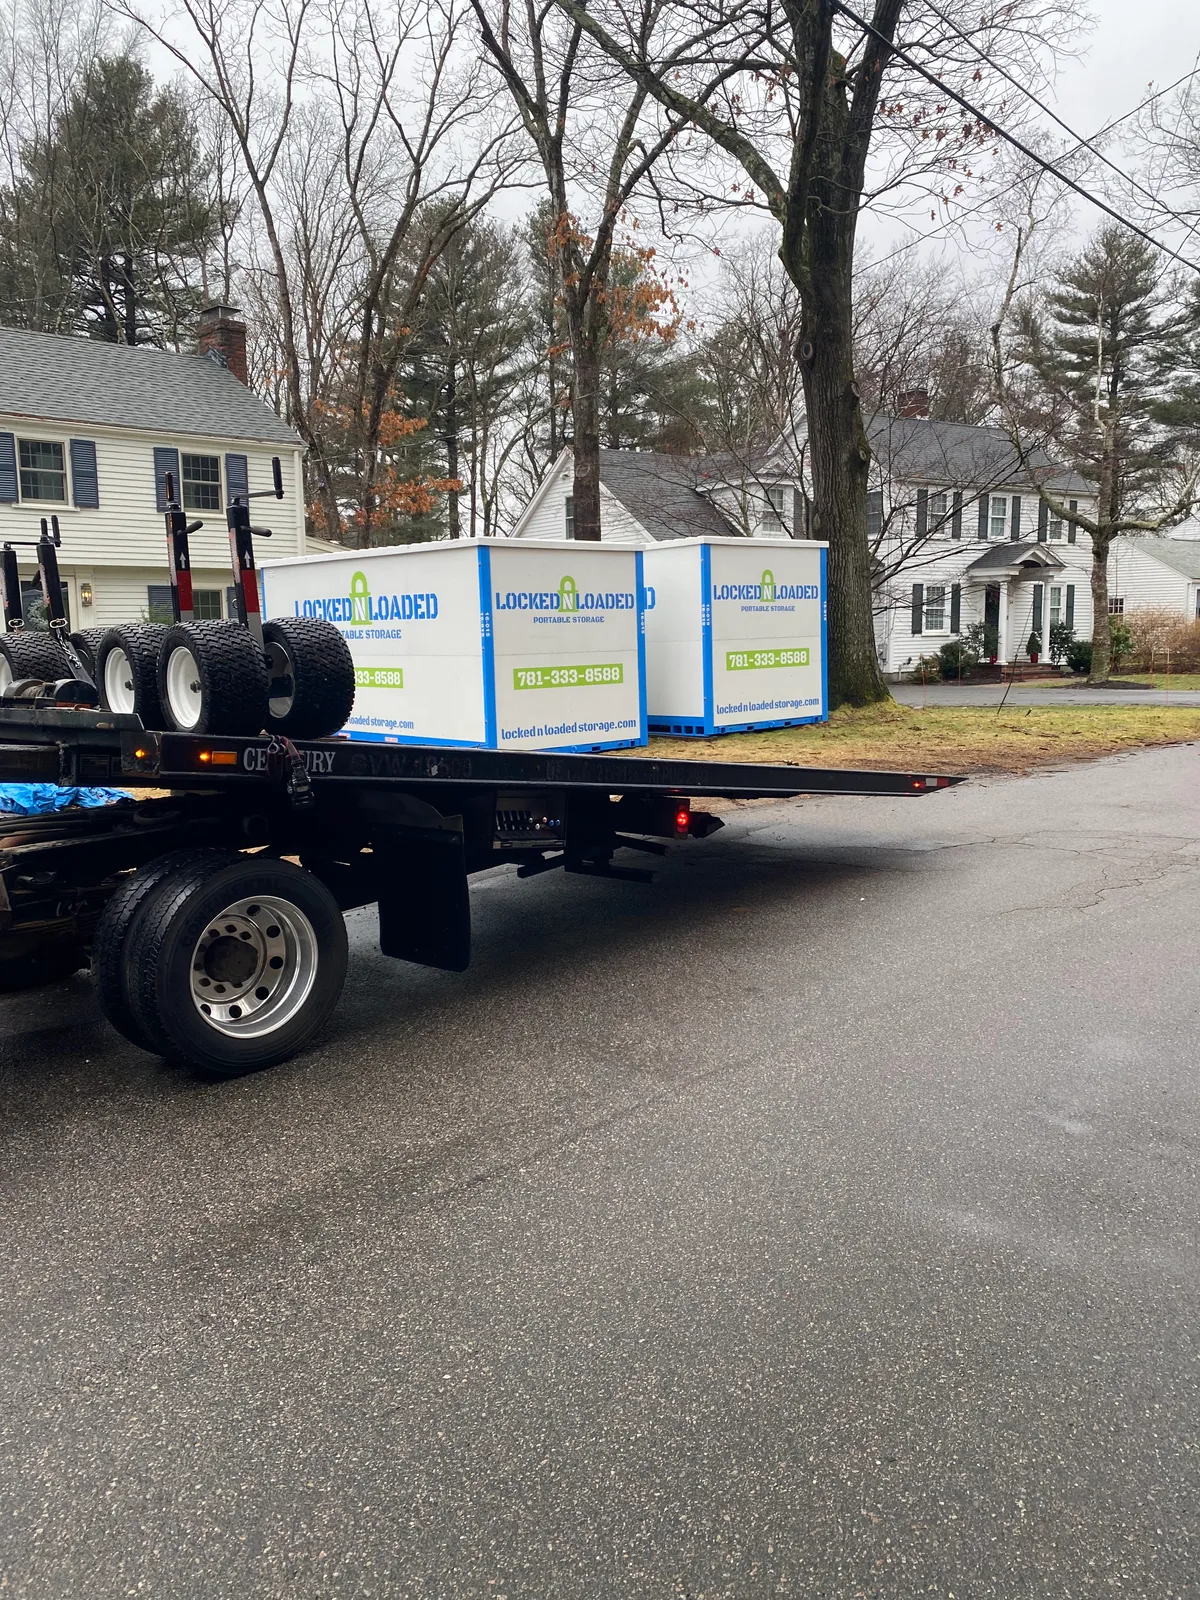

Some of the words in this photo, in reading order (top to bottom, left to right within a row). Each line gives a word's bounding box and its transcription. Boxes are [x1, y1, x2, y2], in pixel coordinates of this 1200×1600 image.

[496, 592, 559, 610] LOCKED
[575, 593, 634, 609] LOADED
[713, 585, 761, 600] LOCKED
[773, 585, 818, 599] LOADED
[295, 597, 351, 622] LOCKED
[368, 593, 438, 620] LOADED
[533, 616, 571, 624] PORTABLE
[341, 630, 364, 639] TABLE
[365, 629, 401, 639] STORAGE
[729, 651, 807, 668] 781-333-8588
[517, 667, 620, 687] 781-333-8588
[243, 747, 336, 773] CEURY
